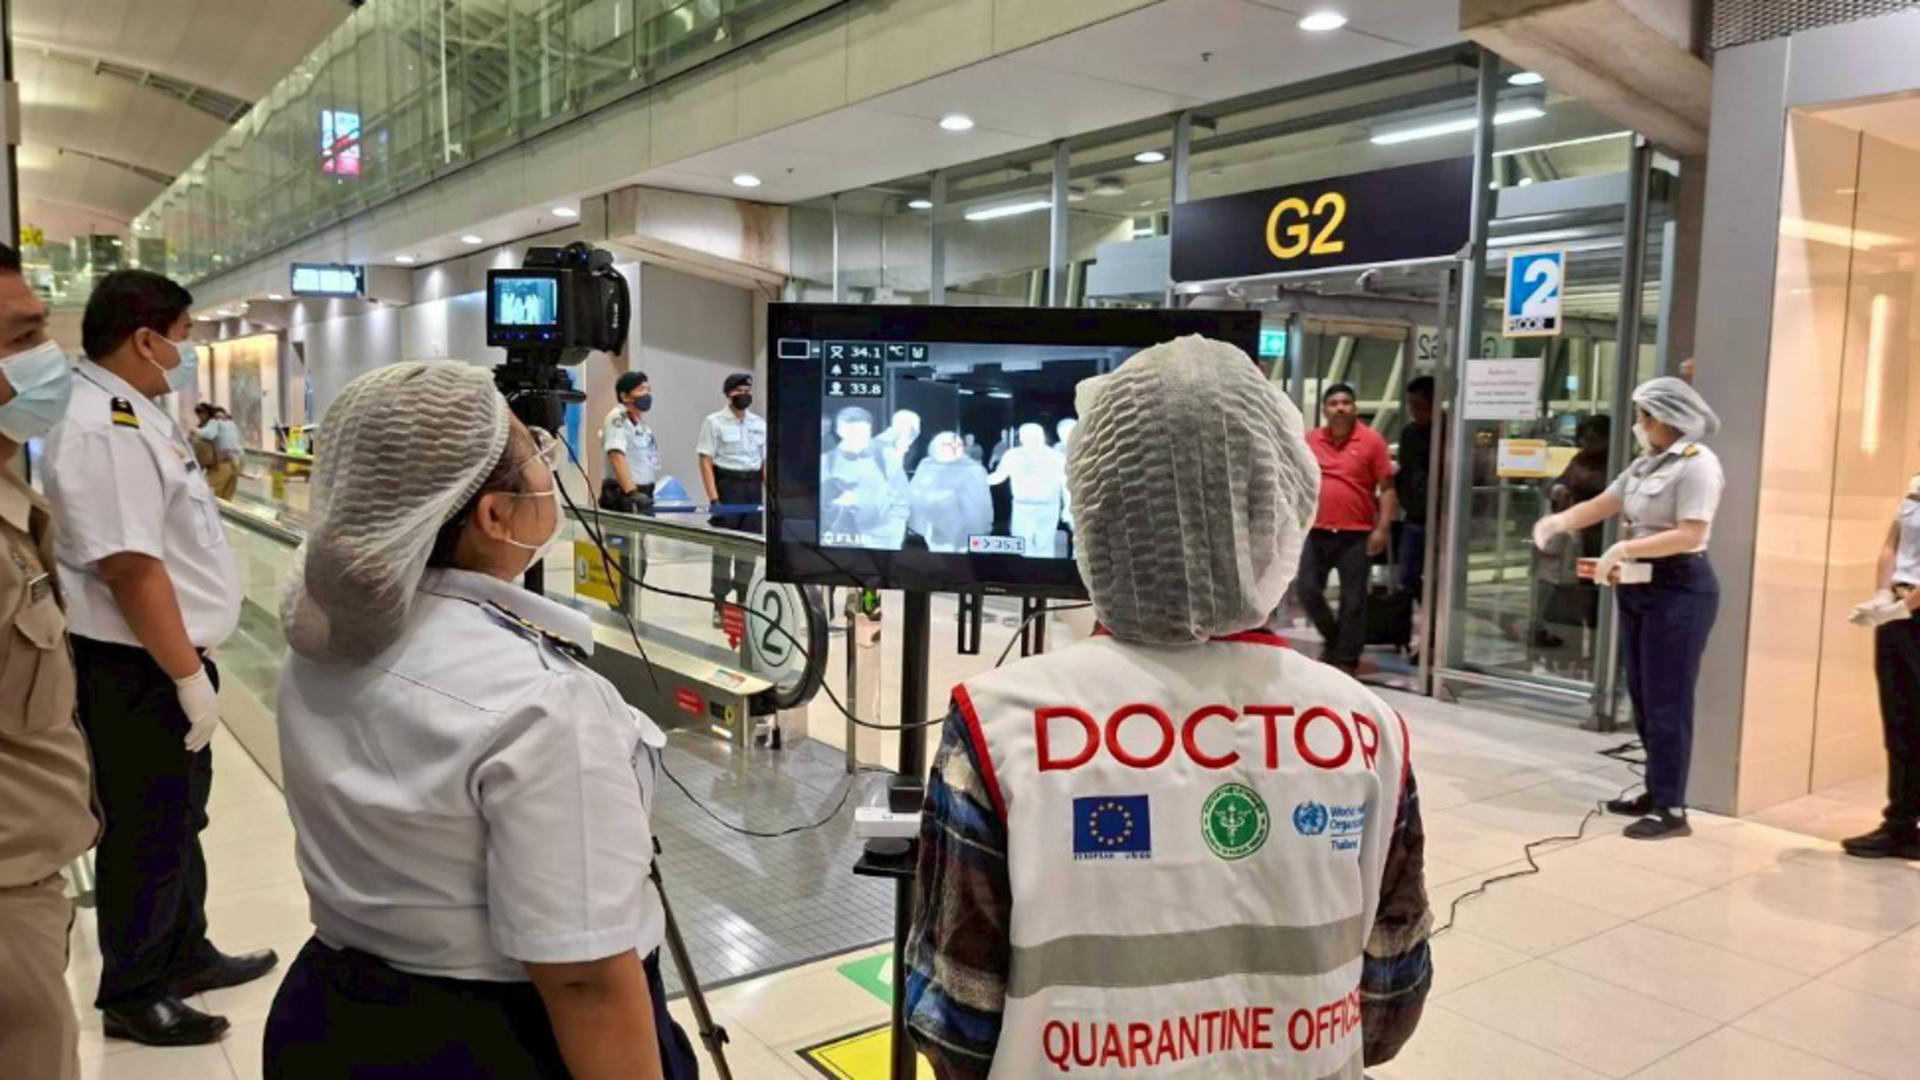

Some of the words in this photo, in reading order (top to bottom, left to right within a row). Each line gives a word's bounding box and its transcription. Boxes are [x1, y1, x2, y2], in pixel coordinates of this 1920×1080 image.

[1266, 192, 1346, 259] G2
[1521, 258, 1560, 316] 2
[850, 346, 881, 358] 34.1
[850, 364, 881, 376] 35.1
[850, 383, 881, 395] 33.8
[762, 590, 783, 655] 2
[1035, 704, 1379, 772] DOCTOR
[1043, 1007, 1274, 1072] QUARANTINE
